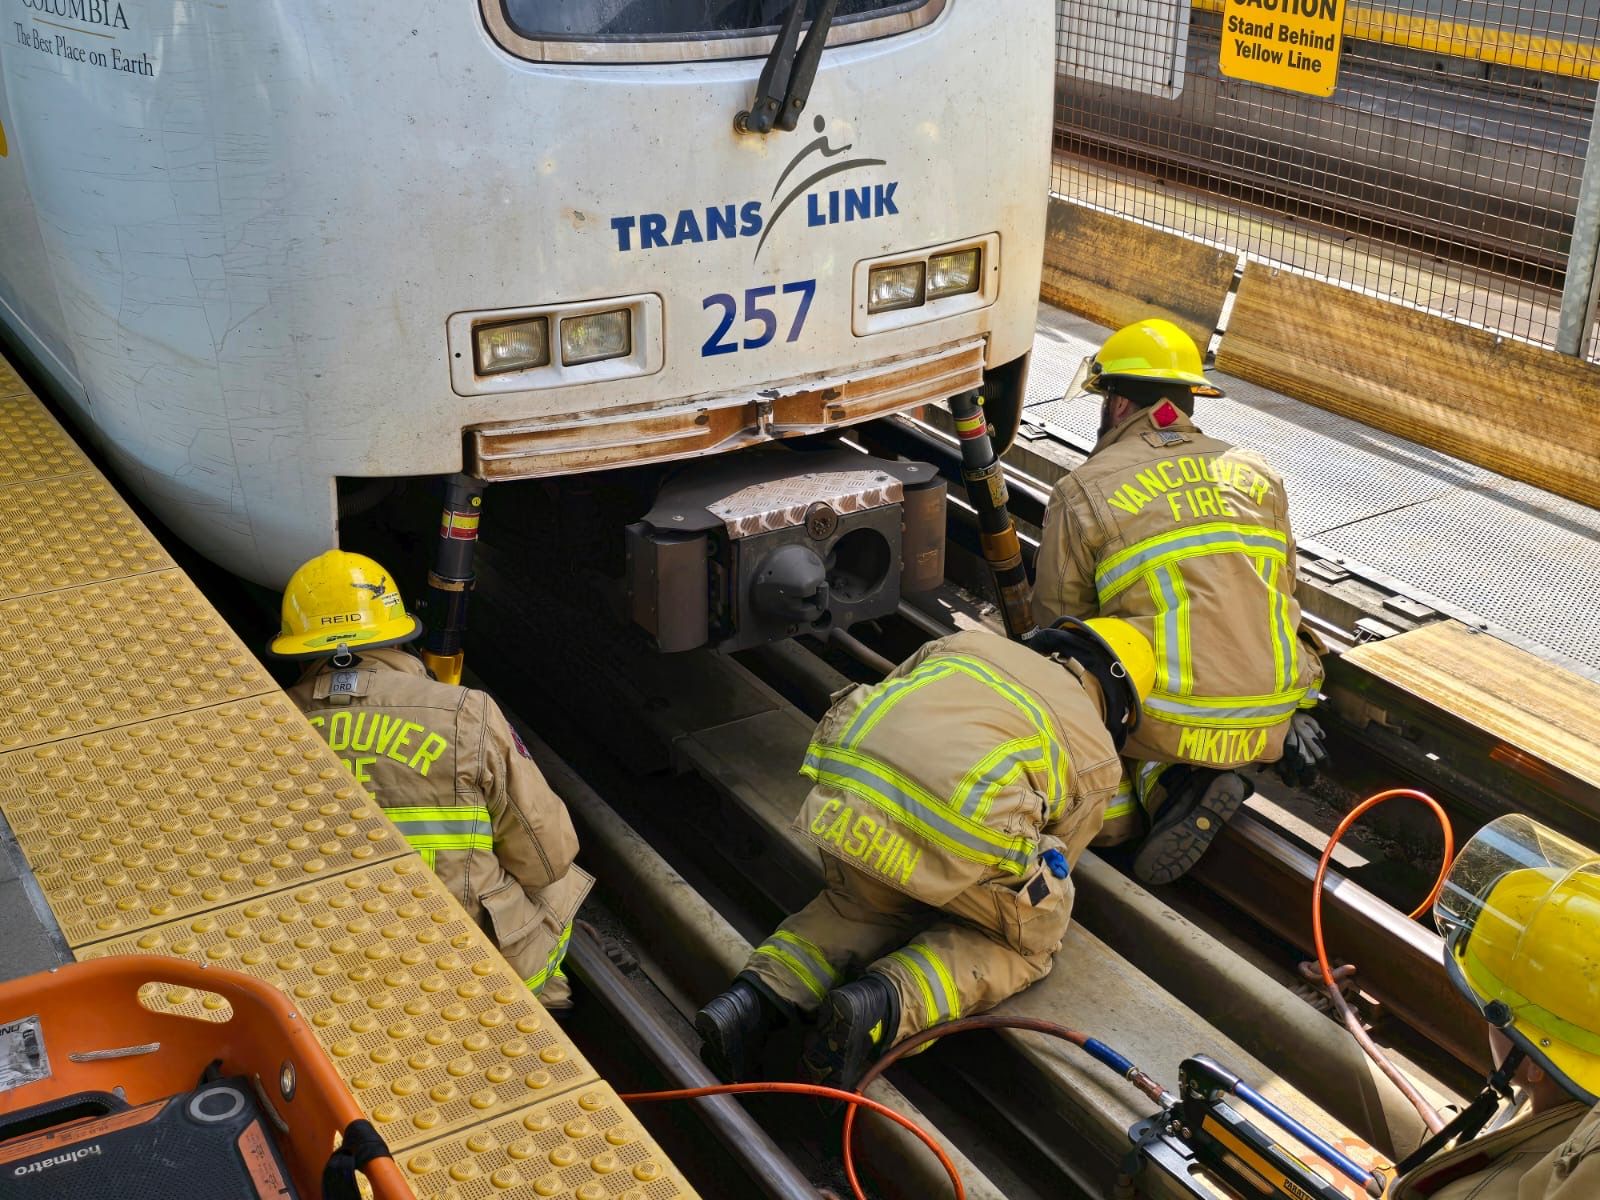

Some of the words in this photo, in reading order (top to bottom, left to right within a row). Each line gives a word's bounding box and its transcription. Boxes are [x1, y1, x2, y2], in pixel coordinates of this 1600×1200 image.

[1228, 15, 1274, 40] Stand
[1278, 24, 1335, 52] Behind
[1233, 0, 1337, 21] TION
[14, 22, 31, 47] The
[32, 28, 54, 55] Best
[55, 35, 86, 63] Place
[89, 51, 107, 68] on
[111, 48, 154, 77] Earth
[1234, 39, 1283, 65] Yellow
[1287, 50, 1322, 73] Line
[610, 201, 764, 252] TRANS
[807, 182, 900, 228] LINK
[701, 279, 817, 358] 257
[1107, 456, 1271, 516] VANCOUVER
[1167, 486, 1236, 522] FIRE
[321, 613, 362, 625] REID
[309, 711, 448, 777] OUVER
[810, 799, 923, 887] CASHIN
[14, 1144, 102, 1176] holmatro
